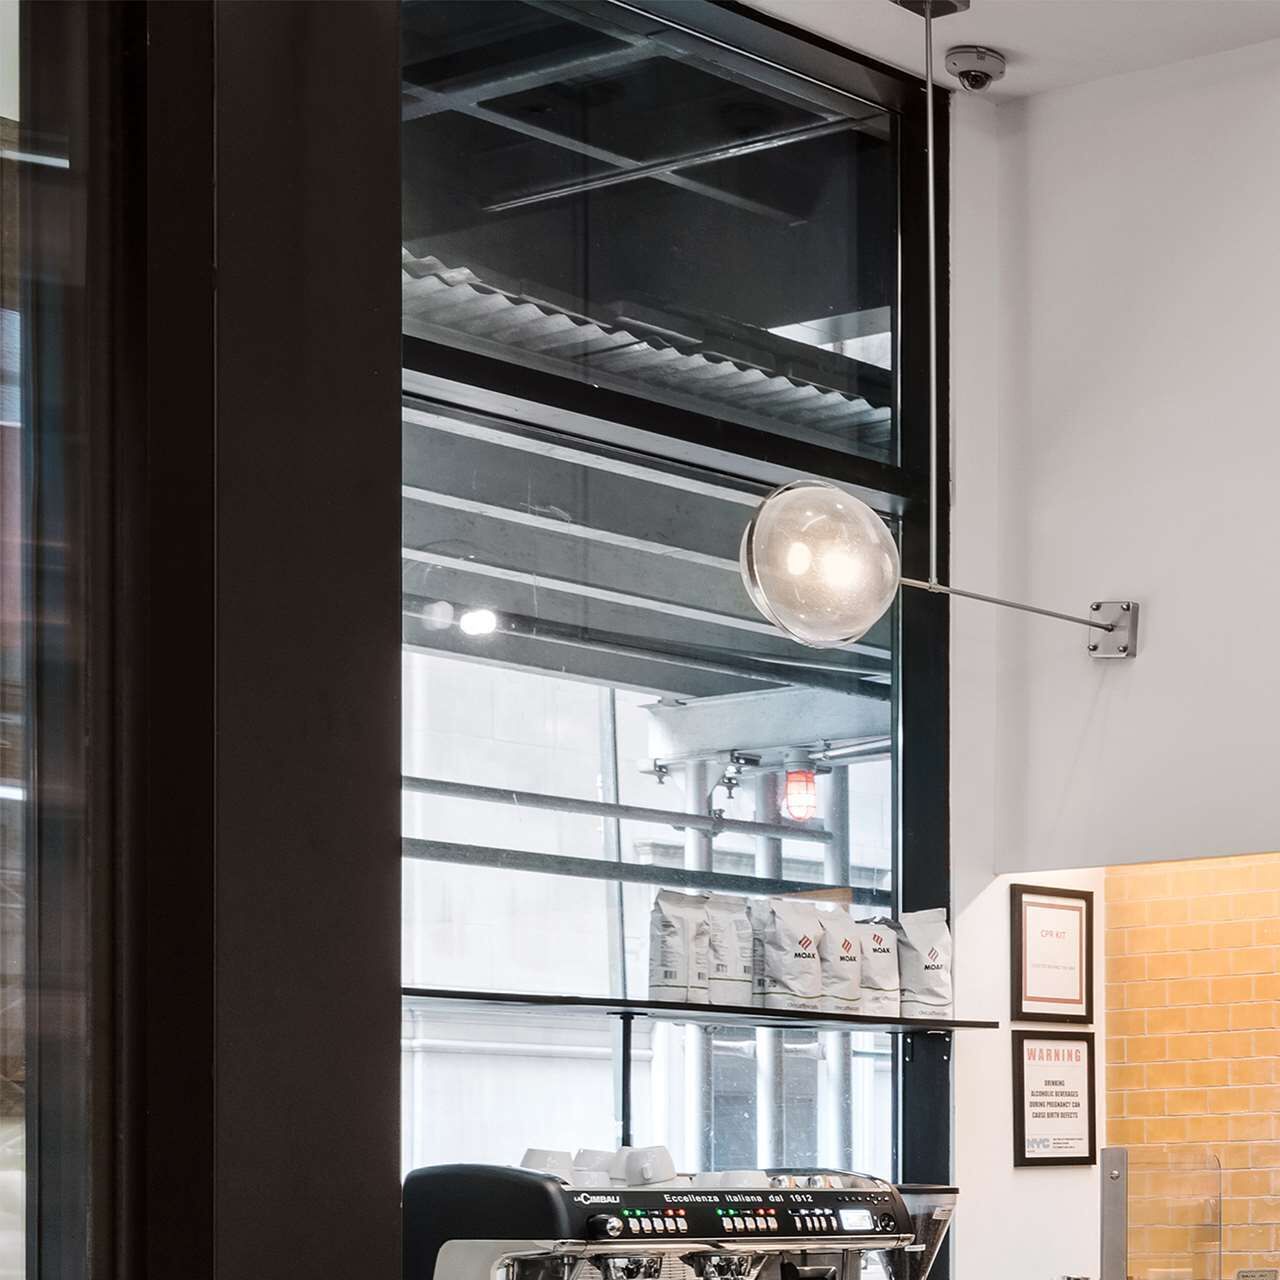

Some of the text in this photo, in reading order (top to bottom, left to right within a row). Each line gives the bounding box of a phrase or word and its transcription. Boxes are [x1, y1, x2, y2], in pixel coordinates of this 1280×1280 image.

[794, 951, 816, 960] MOAK
[839, 954, 857, 962] MOAK
[1027, 1047, 1081, 1062] WARNING
[1031, 1090, 1054, 1098] ALCOHOLIC
[1032, 1111, 1079, 1119] CAUSE BIRTH DEFECTS
[1027, 1138, 1050, 1149] NYC
[664, 1194, 814, 1203] Eccellenza italiana dal 1912
